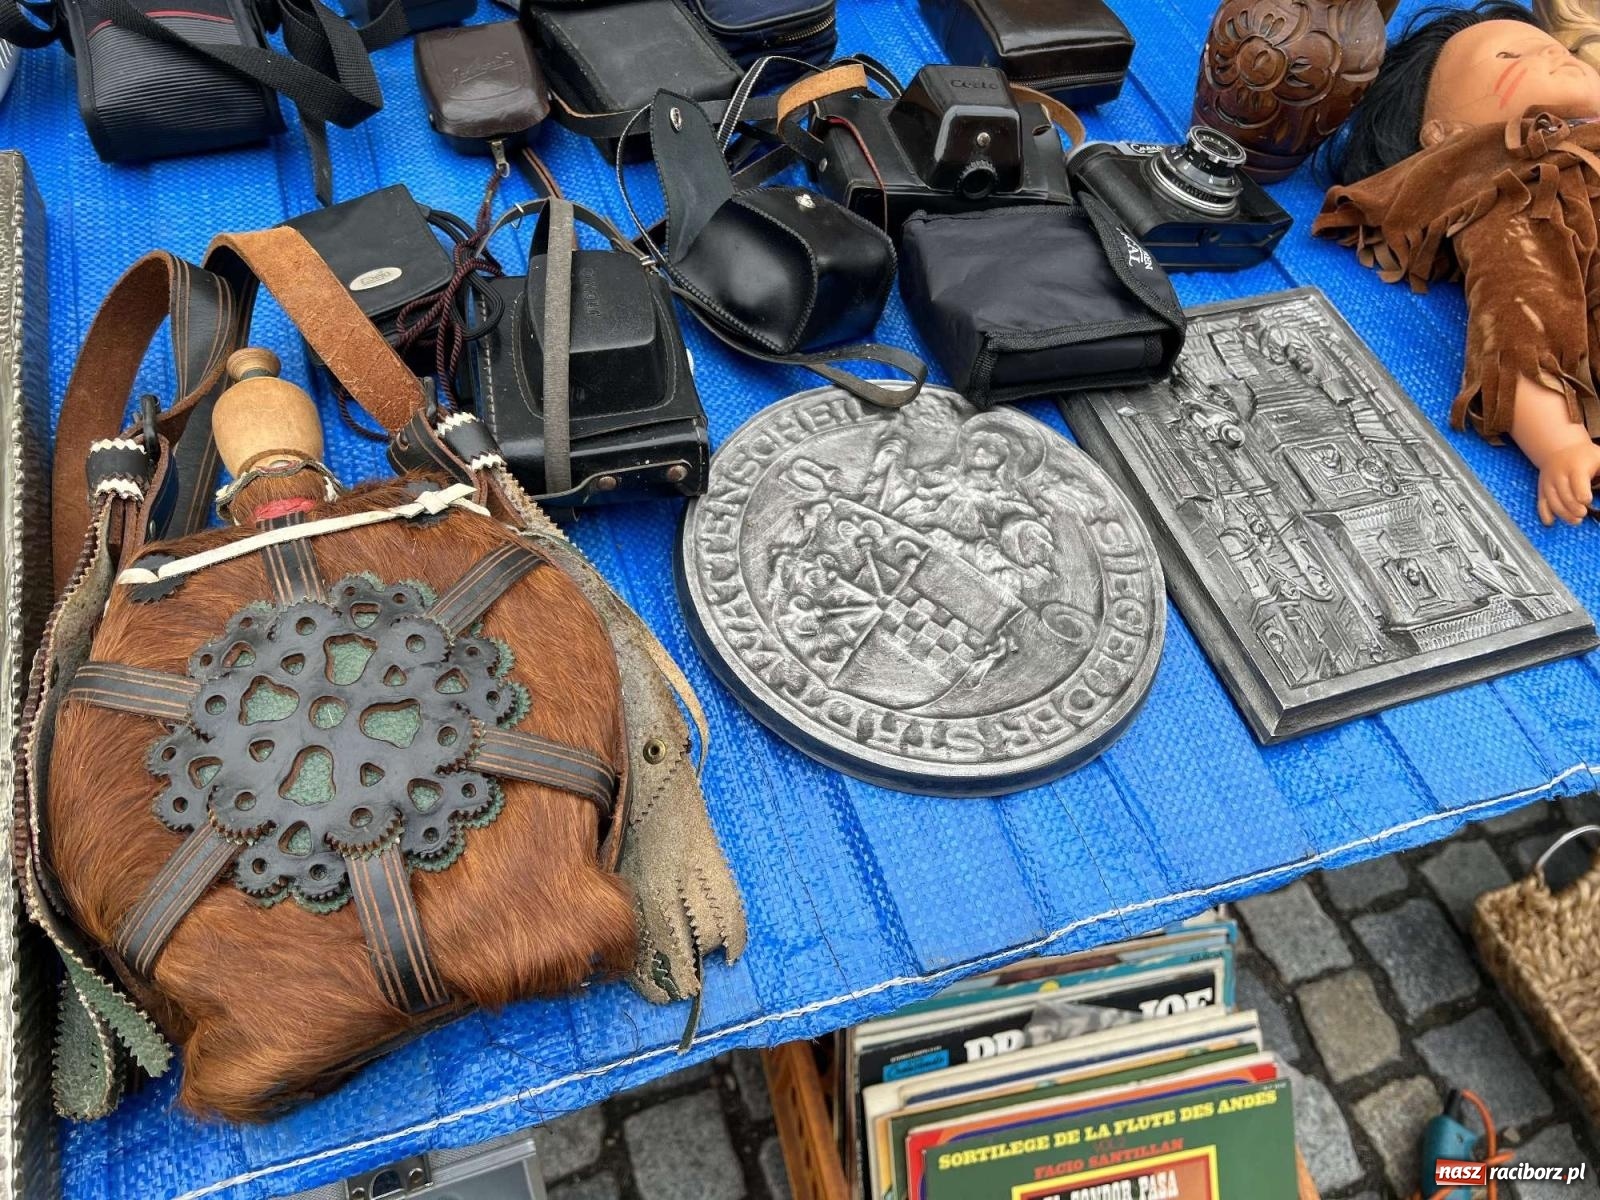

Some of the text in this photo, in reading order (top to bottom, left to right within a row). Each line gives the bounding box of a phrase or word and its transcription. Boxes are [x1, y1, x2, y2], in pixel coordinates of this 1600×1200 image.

[1000, 684, 1112, 754] DER
[938, 1090, 1277, 1170] SORTILEGE DE LA FLUTE DES ANDES
[1034, 1138, 1184, 1180] FACIO SANTILLAN
[1138, 1169, 1179, 1200] PASA
